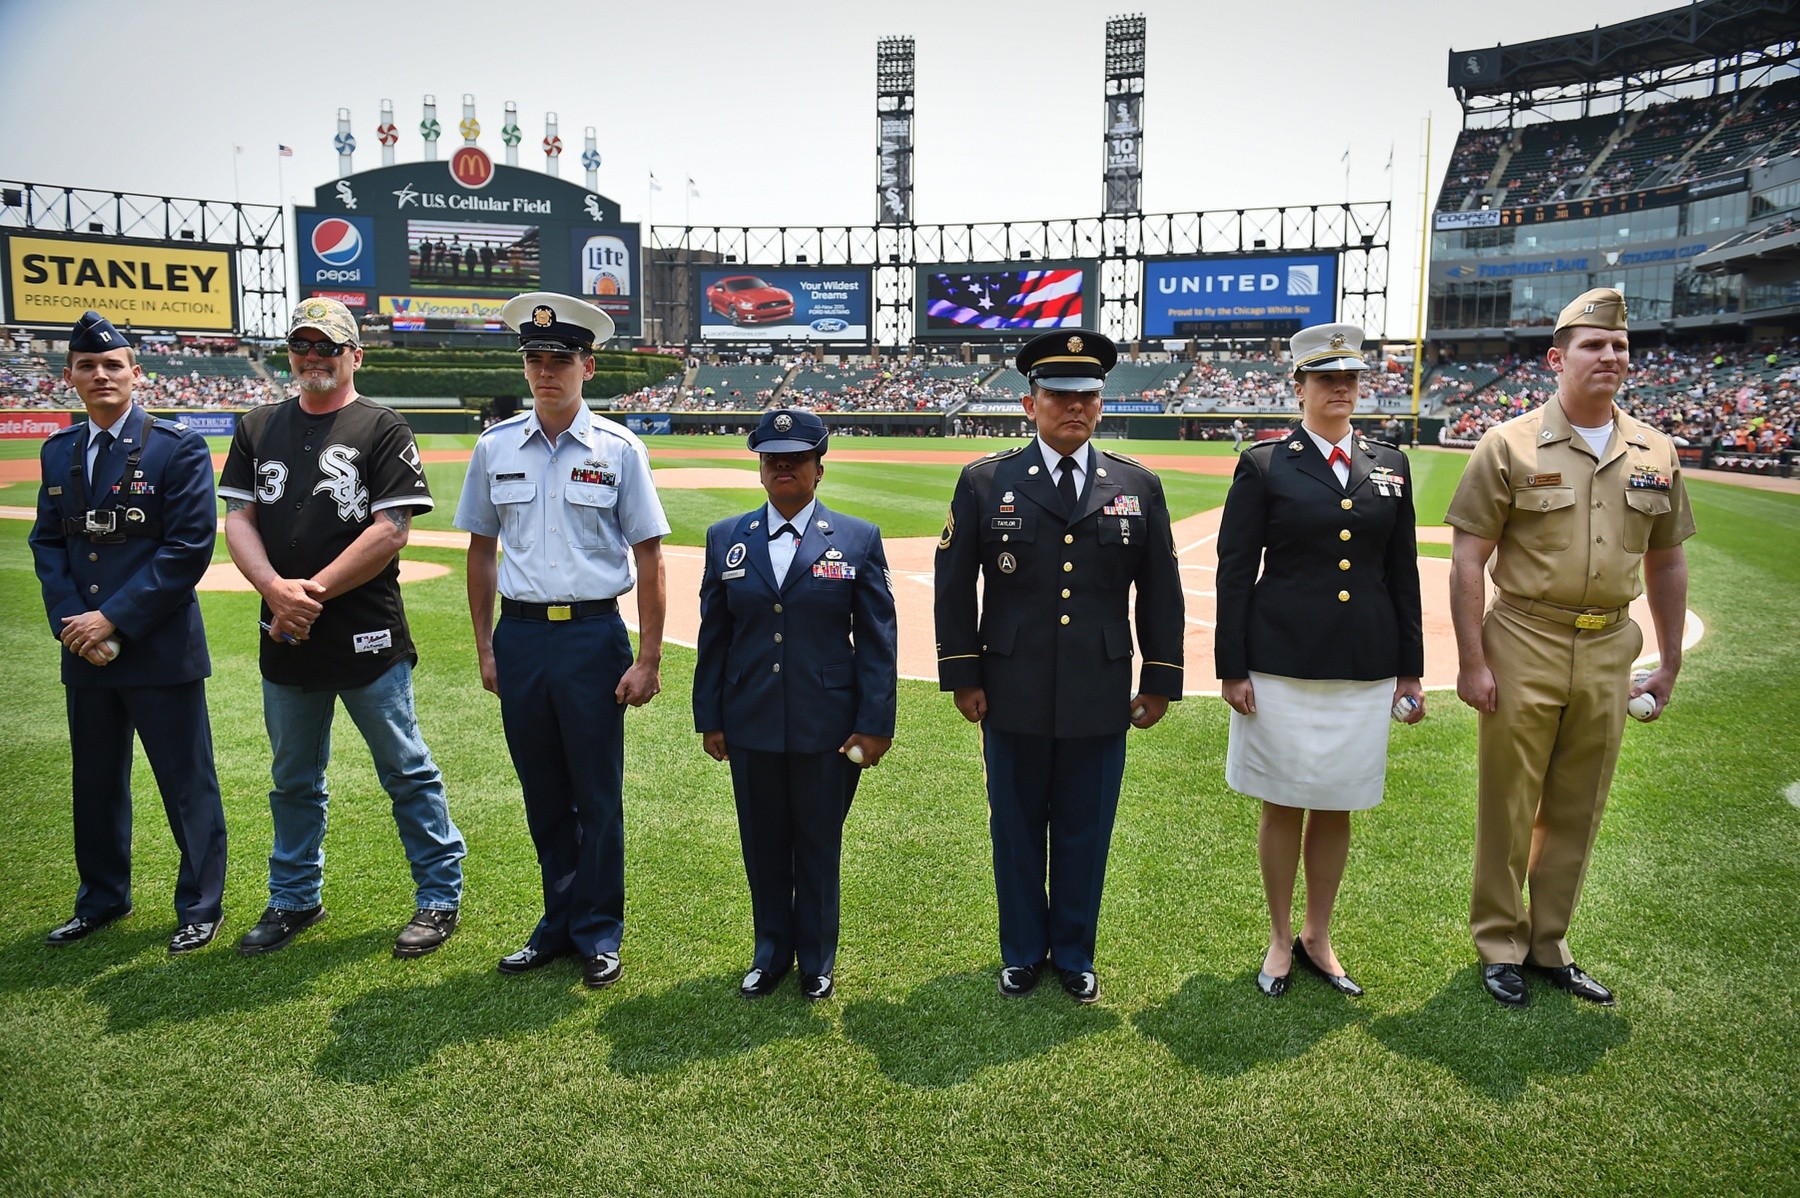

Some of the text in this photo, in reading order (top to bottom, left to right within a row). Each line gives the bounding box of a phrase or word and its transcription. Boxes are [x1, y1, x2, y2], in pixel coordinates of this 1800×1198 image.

[1111, 138, 1134, 155] 10
[1109, 154, 1137, 163] YEAR
[421, 193, 551, 214] U.S. Cellular Field
[1438, 211, 1498, 223] COOPER
[588, 247, 623, 270] Lite
[1621, 249, 1677, 266] STADIUM
[22, 253, 218, 293] STANLEY
[316, 268, 360, 283] pepsi
[800, 281, 859, 291] Your Wildest
[1158, 273, 1280, 295] UNITED
[811, 291, 848, 300] Dreams
[25, 294, 215, 314] PERFORMANCE IN ACTION
[416, 299, 468, 315] Vienna
[1167, 308, 1192, 316] Proud
[1194, 308, 1203, 316] to
[1217, 307, 1231, 315] the
[1232, 306, 1266, 316] Chicago
[1267, 305, 1293, 314] White
[1294, 305, 1311, 314] Sox
[816, 319, 841, 332] Ford
[988, 403, 1024, 412] HYUND
[1112, 404, 1160, 412] RELIEVERS
[254, 458, 288, 504] 3
